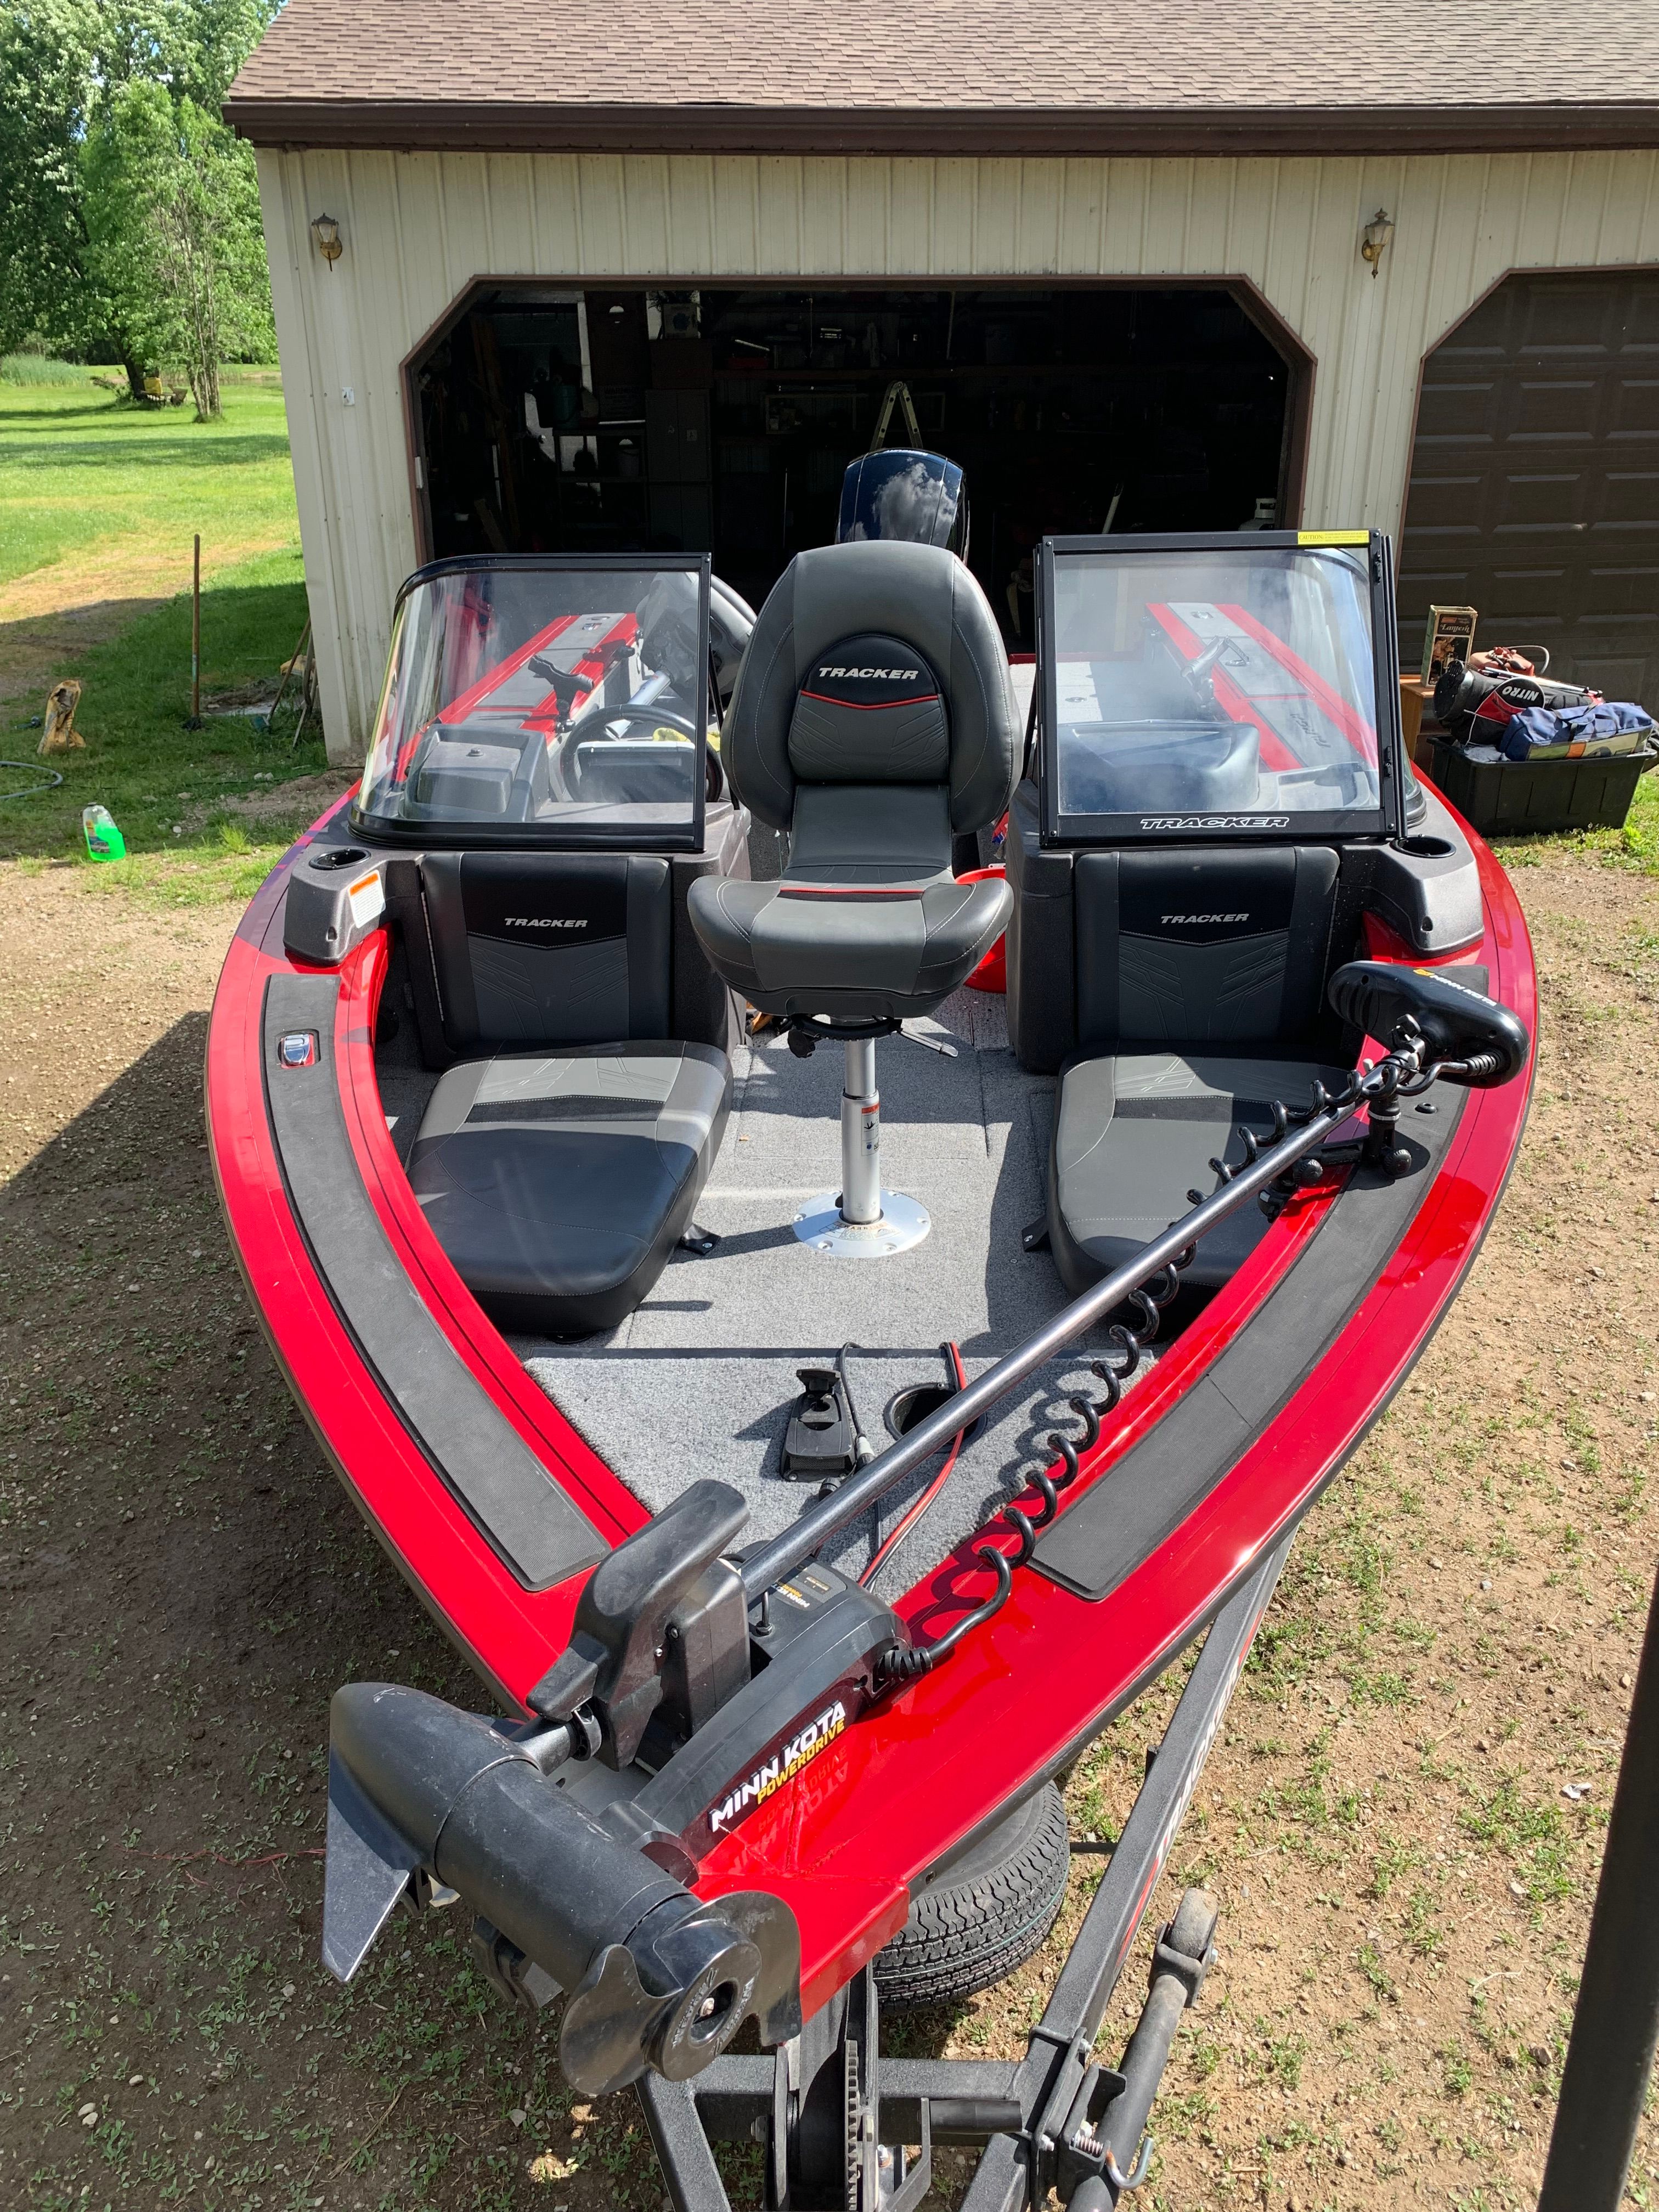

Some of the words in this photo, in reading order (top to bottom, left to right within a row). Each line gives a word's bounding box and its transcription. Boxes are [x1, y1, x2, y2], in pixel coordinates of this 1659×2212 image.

[819, 667, 919, 680] TRACKER
[1502, 686, 1539, 701] NITRO
[1140, 816, 1290, 830] TRACKER
[504, 917, 588, 928] TRACKER
[1160, 912, 1250, 924] TRACKER
[1429, 975, 1465, 990] MINN
[1463, 989, 1497, 1007] KOTA
[787, 1593, 810, 1608] MINN
[708, 1755, 779, 1833] MINN
[782, 1700, 846, 1767] KOTA
[757, 1717, 845, 1805] POWERDRIVE
[1155, 1659, 1240, 1867] TRACKER
